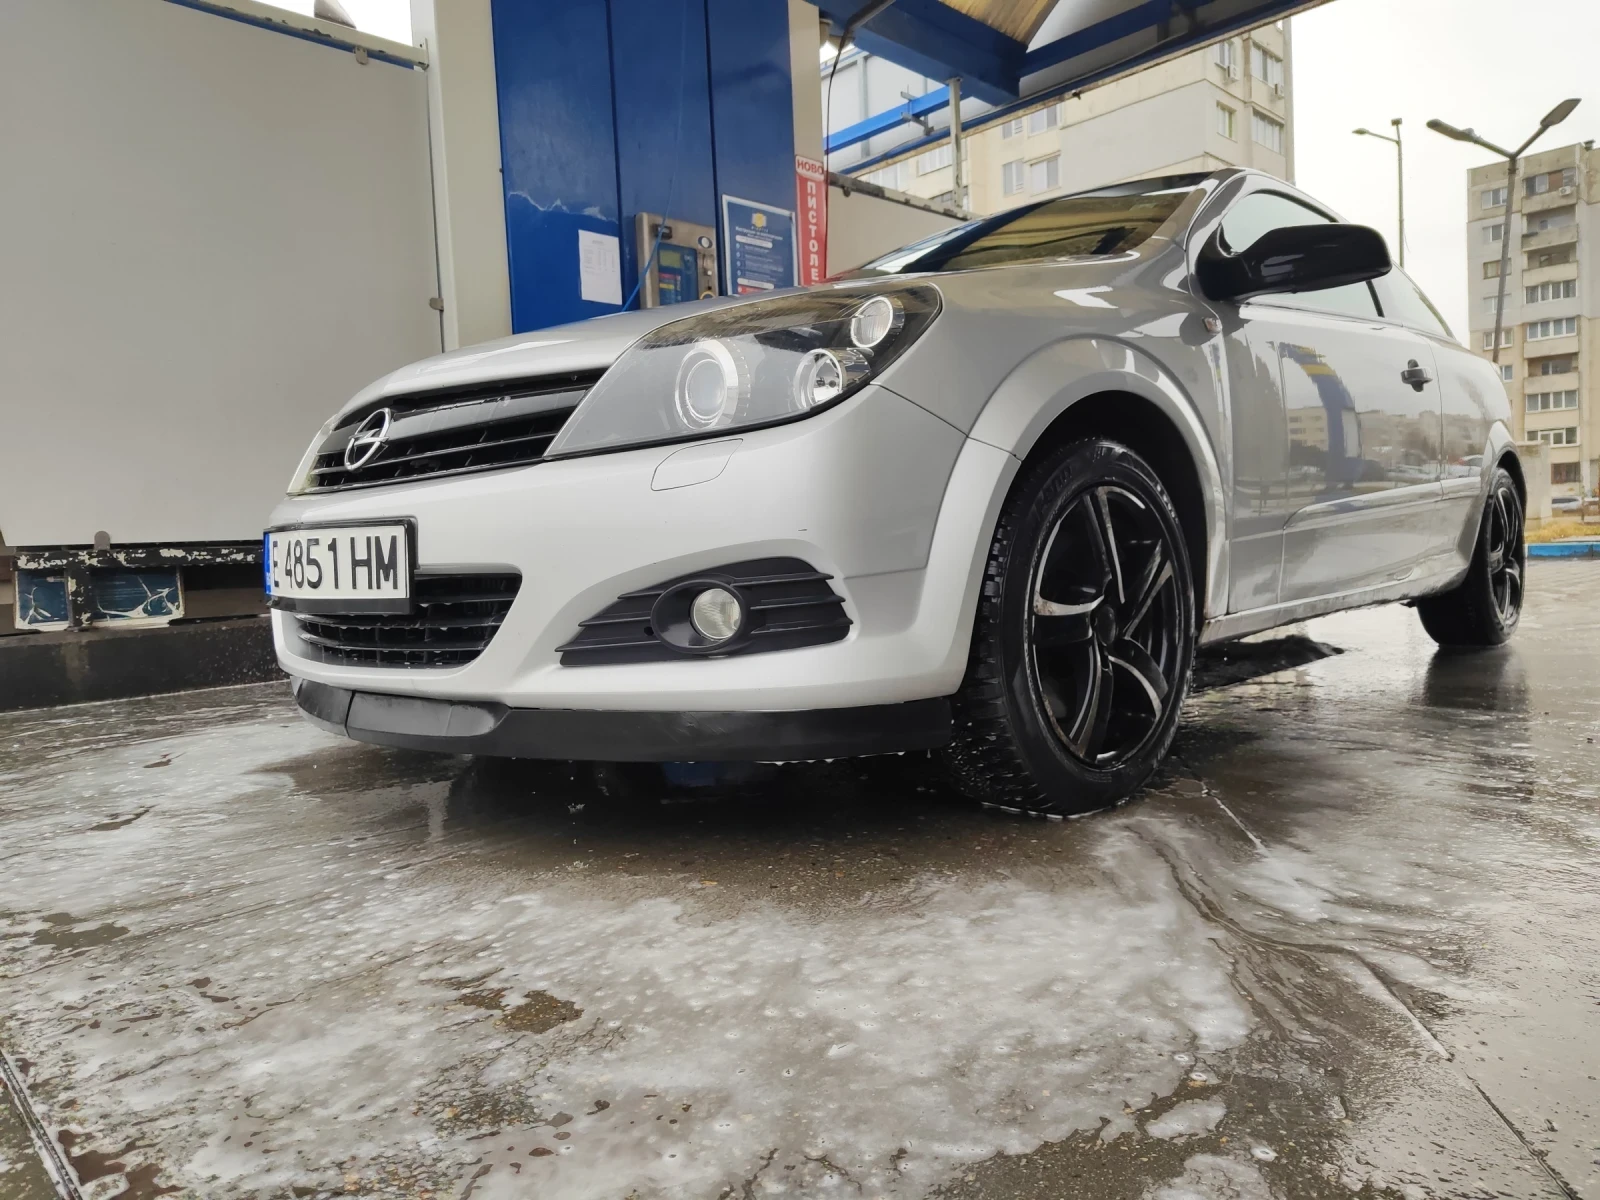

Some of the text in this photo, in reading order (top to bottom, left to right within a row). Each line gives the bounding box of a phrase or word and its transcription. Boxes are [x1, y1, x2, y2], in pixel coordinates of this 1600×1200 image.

[797, 159, 824, 175] НОВО
[807, 180, 820, 285] ПИСТОЛЕ
[272, 535, 398, 590] E 4851 HM
